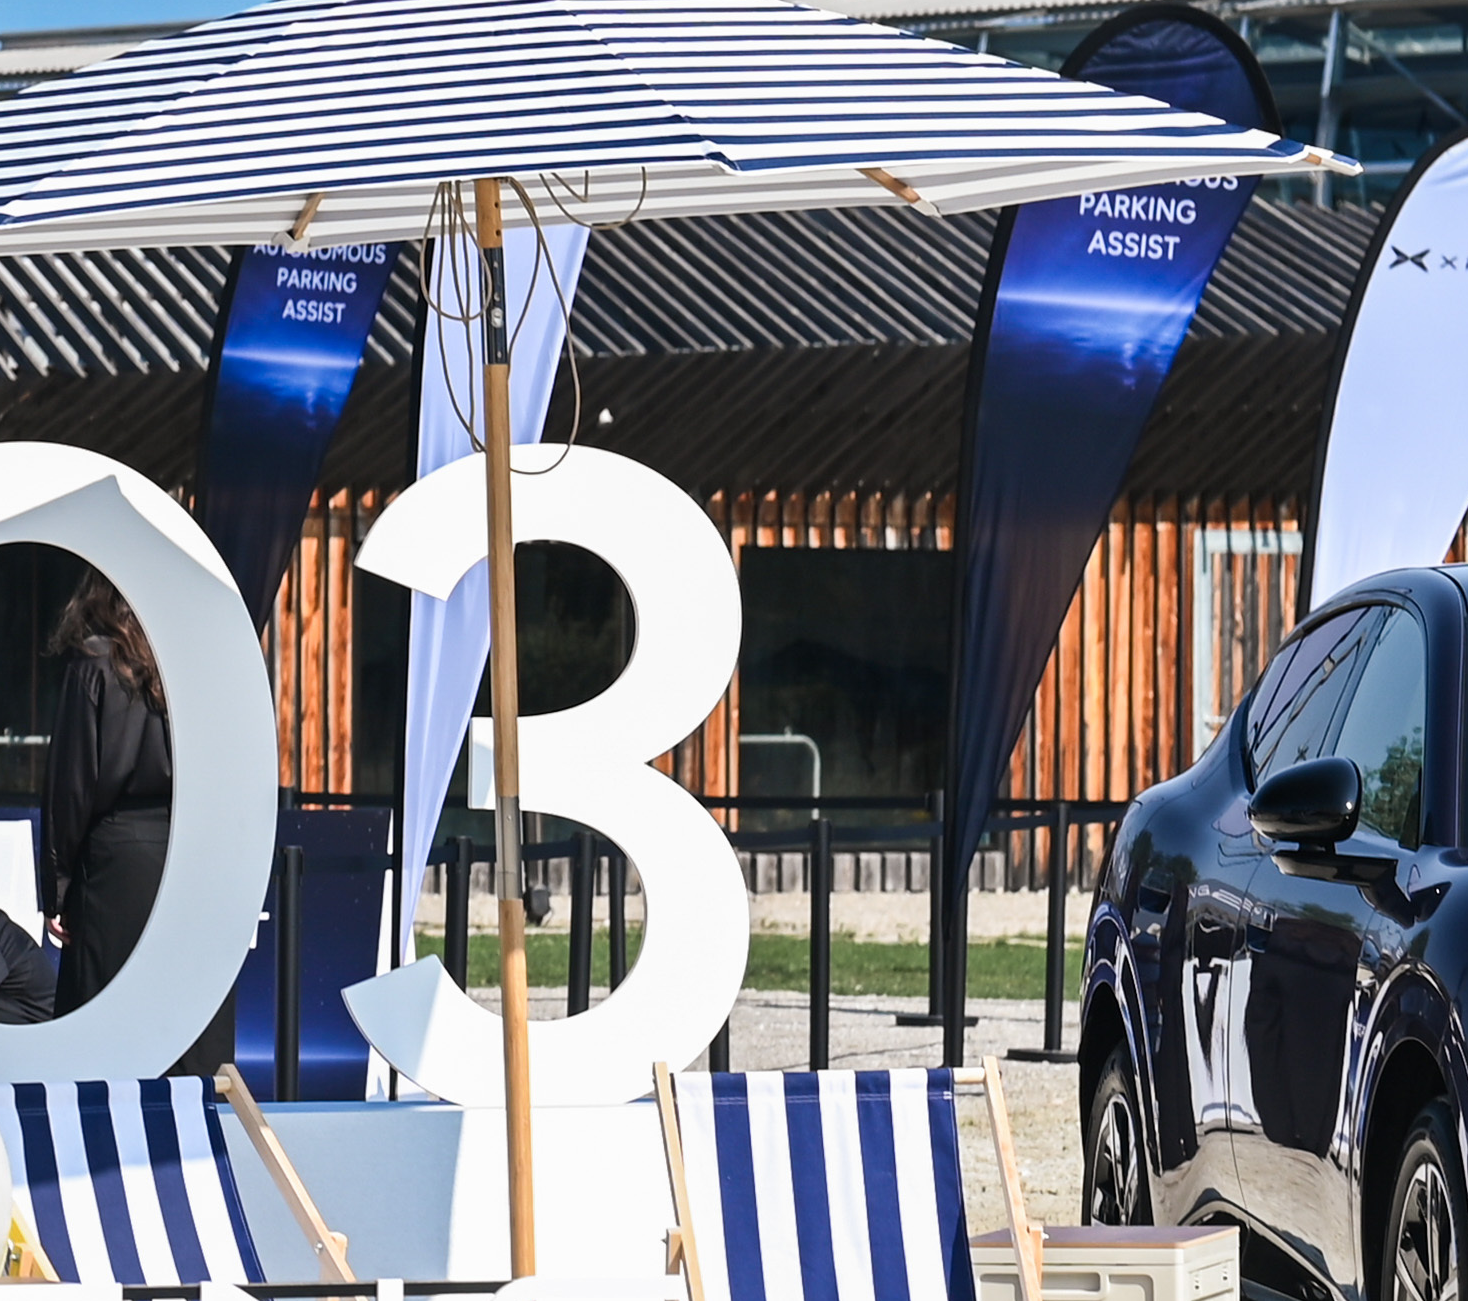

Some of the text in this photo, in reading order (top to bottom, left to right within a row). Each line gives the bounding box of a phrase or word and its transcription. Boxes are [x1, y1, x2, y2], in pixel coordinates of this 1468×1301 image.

[1079, 193, 1197, 225] PARKING
[1087, 229, 1180, 261] ASSIST
[276, 267, 358, 294] PARKING
[282, 299, 347, 324] ASSIST
